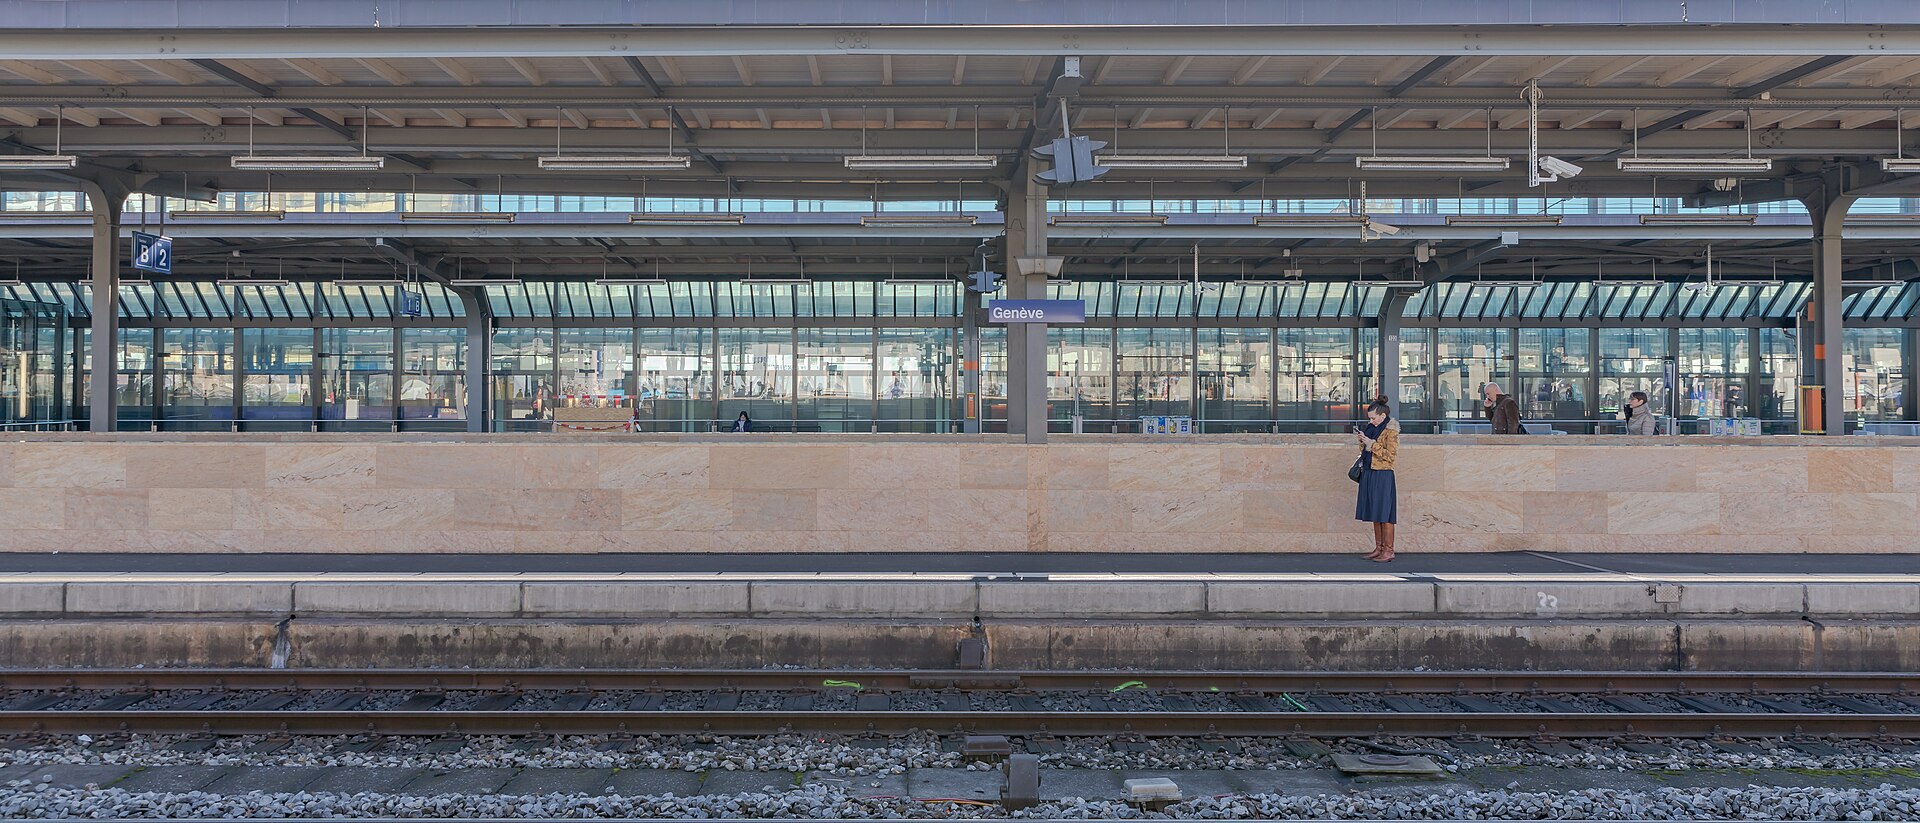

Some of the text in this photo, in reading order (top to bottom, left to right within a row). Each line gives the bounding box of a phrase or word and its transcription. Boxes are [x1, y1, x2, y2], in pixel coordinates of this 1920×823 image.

[140, 245, 167, 267] B 2
[993, 306, 1044, 319] Genève
